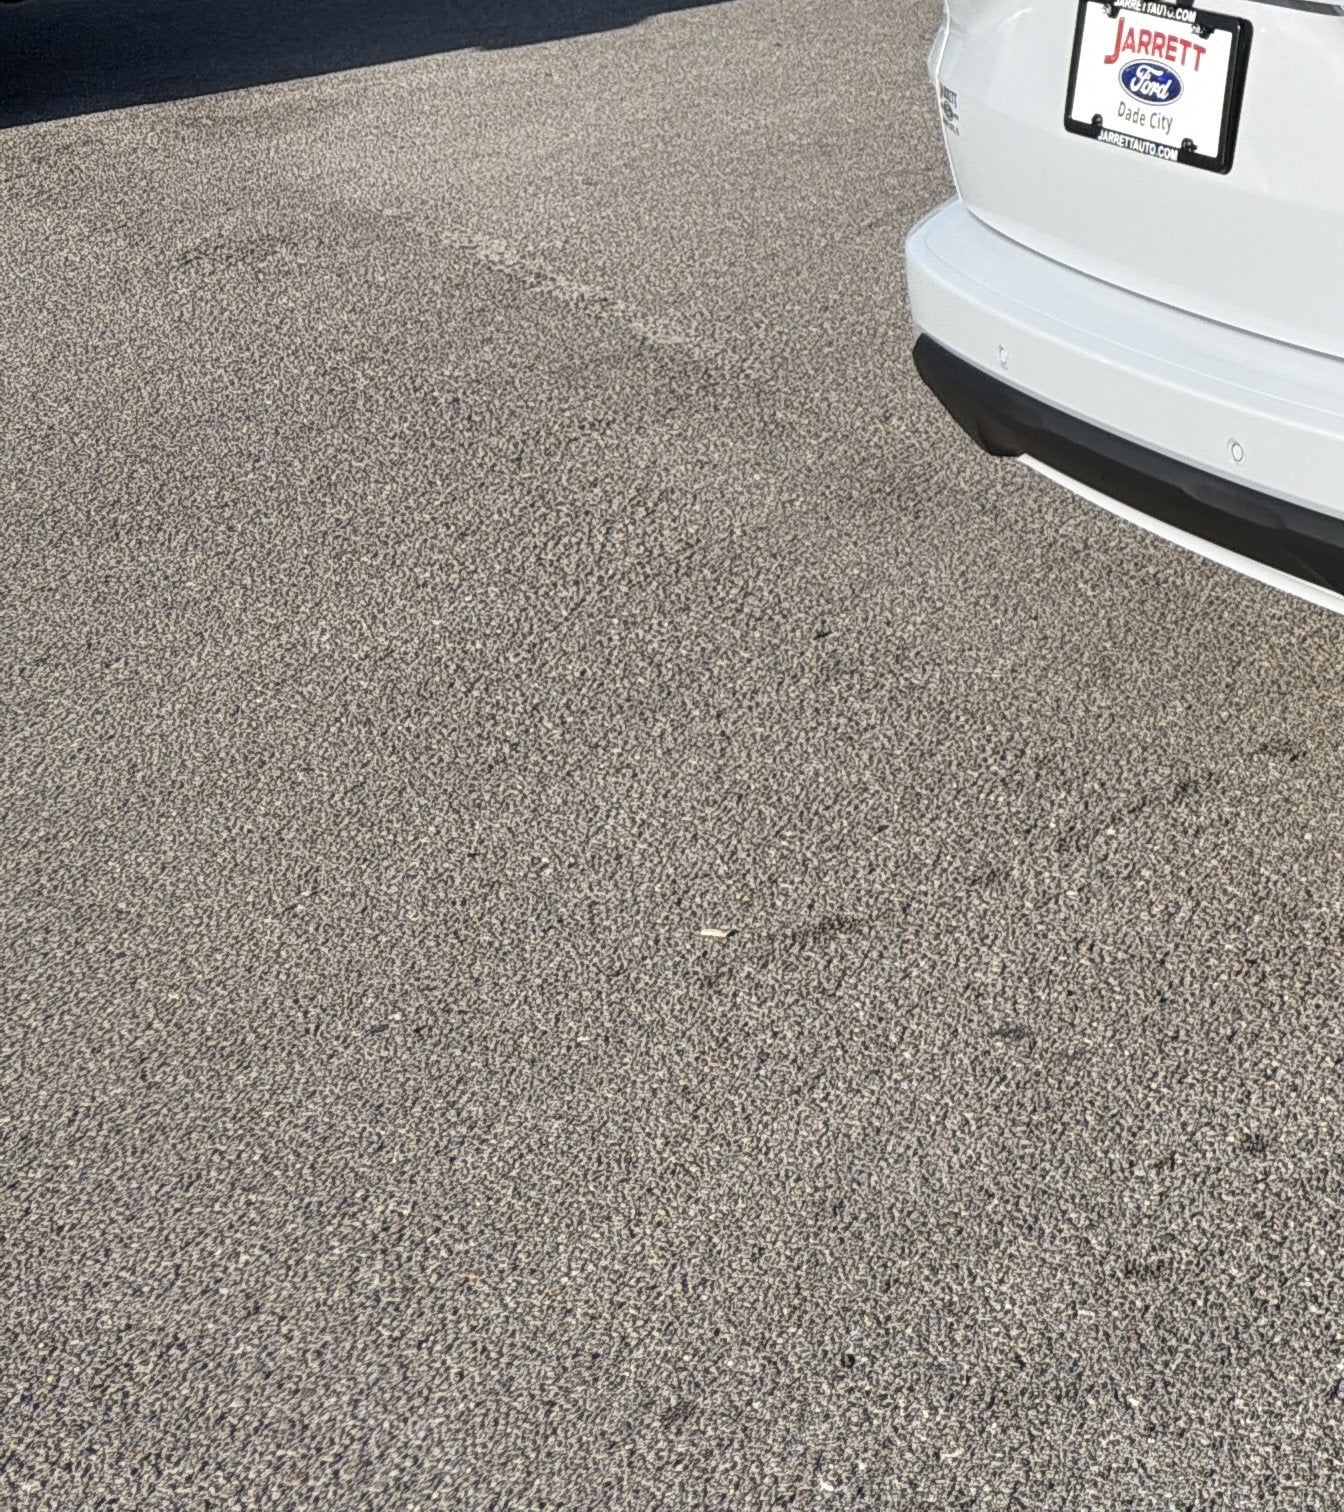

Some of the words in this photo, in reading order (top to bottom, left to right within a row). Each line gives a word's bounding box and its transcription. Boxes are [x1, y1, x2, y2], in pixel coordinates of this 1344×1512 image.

[1104, 16, 1207, 72] JARRETT
[1129, 64, 1172, 99] Ford
[1117, 101, 1146, 127] Dade
[1149, 112, 1174, 135] City
[1097, 129, 1179, 162] JARRETTAUTO.COM
